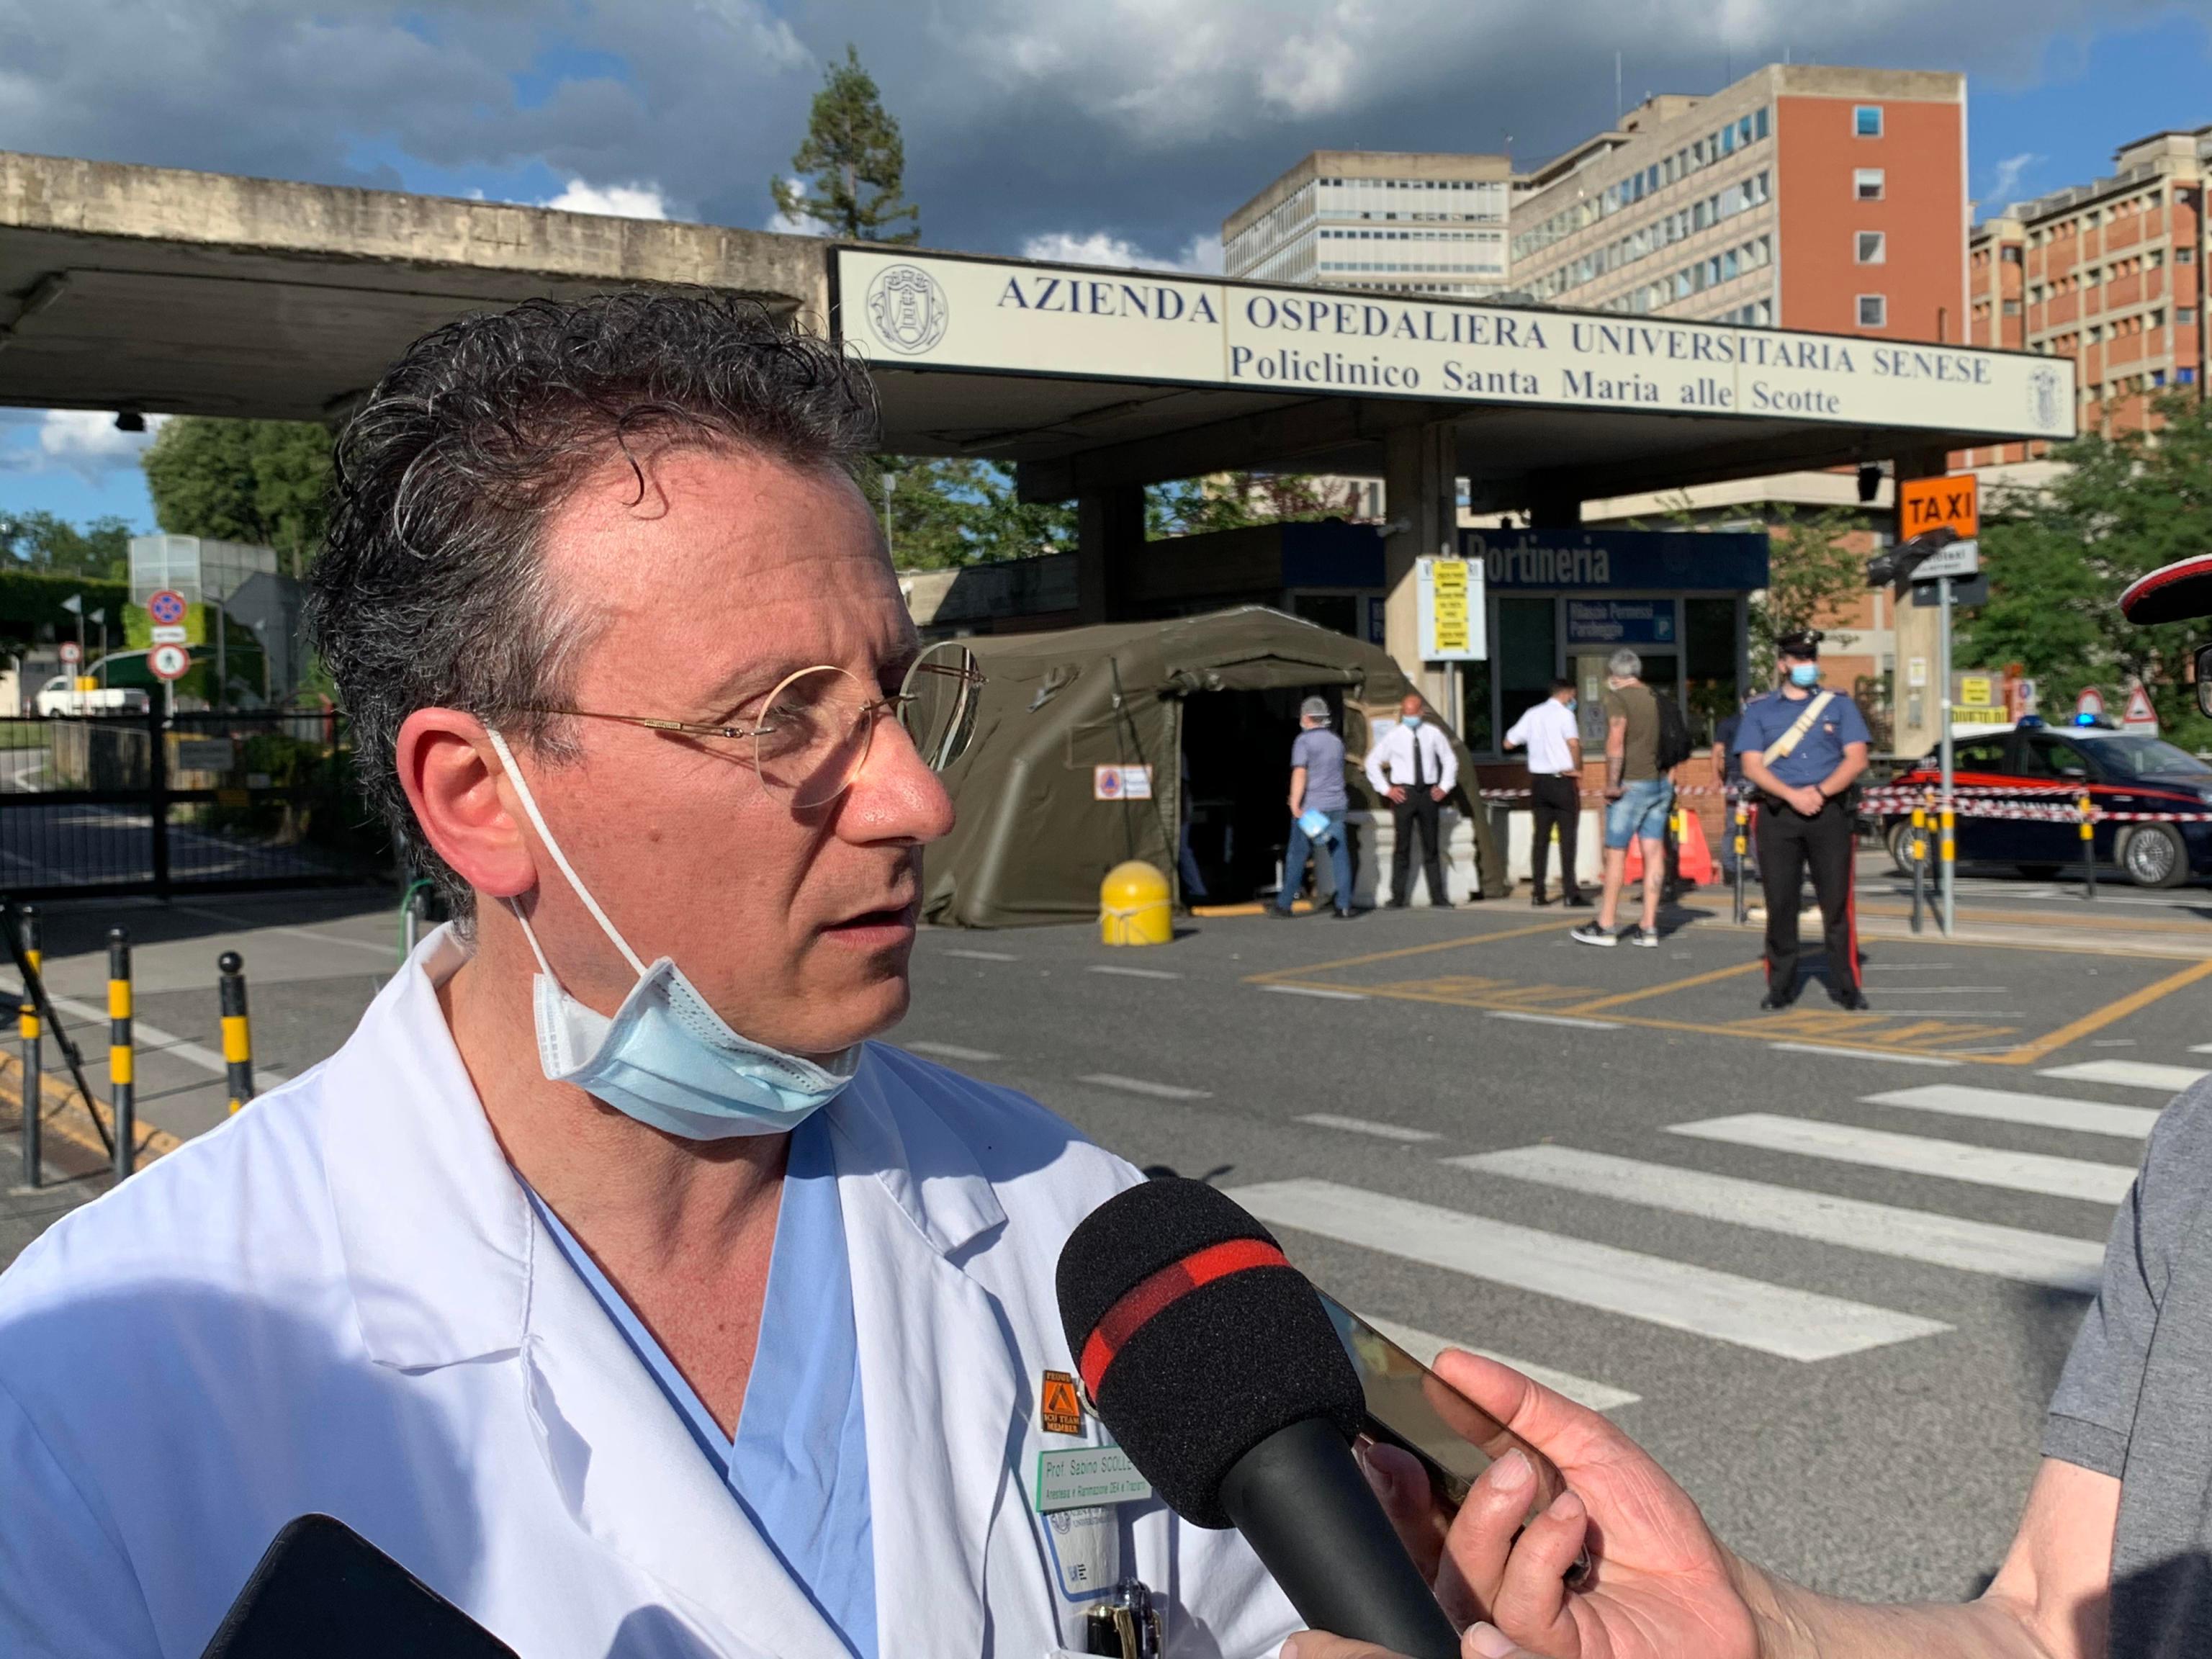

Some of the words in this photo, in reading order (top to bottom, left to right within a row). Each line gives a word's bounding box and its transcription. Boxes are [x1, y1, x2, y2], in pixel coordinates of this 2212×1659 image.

[996, 275, 1220, 324] AZIENDA
[1246, 295, 1549, 351] OSPEDALIERA
[1570, 322, 1856, 373] UNIVERSITARIA
[1873, 348, 1992, 386] SENESE
[1230, 345, 1420, 390] Policlinico
[1443, 360, 1539, 397] Santa
[1562, 367, 1659, 404] Maria
[1681, 373, 1733, 408] alle
[1751, 380, 1840, 415] Scotte
[1908, 492, 1972, 524] TAXI
[1046, 1422, 1079, 1434] MEMBER
[1059, 1415, 1079, 1426] TEAM
[1070, 1459, 1098, 1475] Sabino
